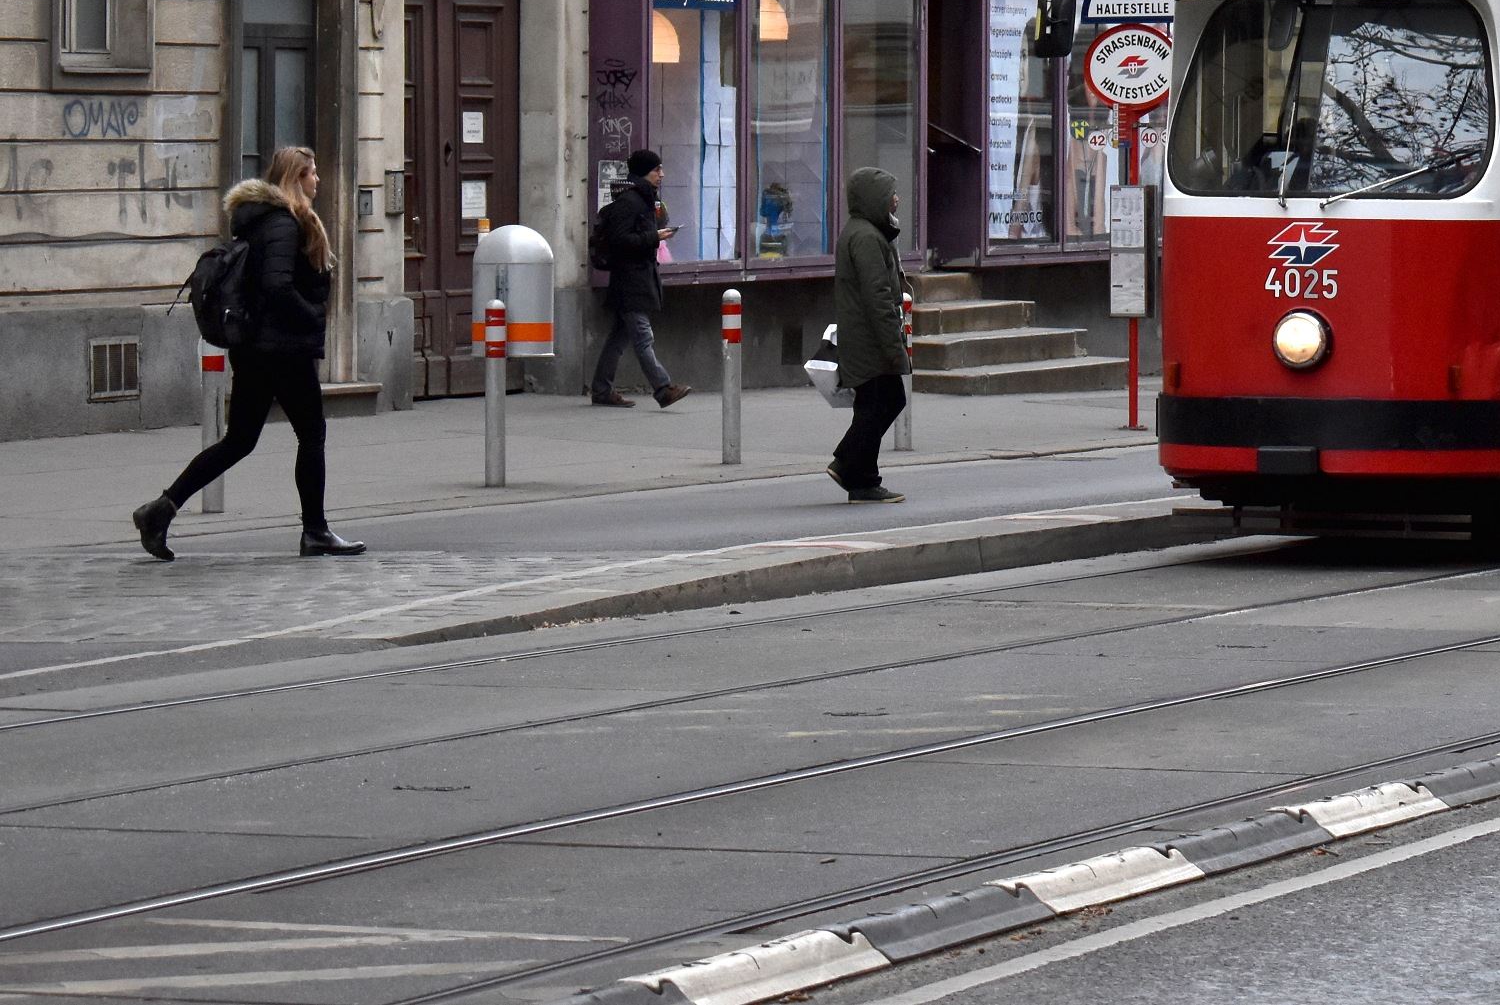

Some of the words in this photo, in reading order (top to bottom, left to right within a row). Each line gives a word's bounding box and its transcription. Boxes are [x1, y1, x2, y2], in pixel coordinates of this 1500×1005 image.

[1096, 2, 1169, 15] HALTESTELLE
[1096, 34, 1170, 65] STRASSENBAHN
[1100, 73, 1168, 99] HALTESTELLE
[1089, 135, 1106, 146] 42
[1142, 132, 1158, 144] 40
[1264, 267, 1339, 300] 4025
